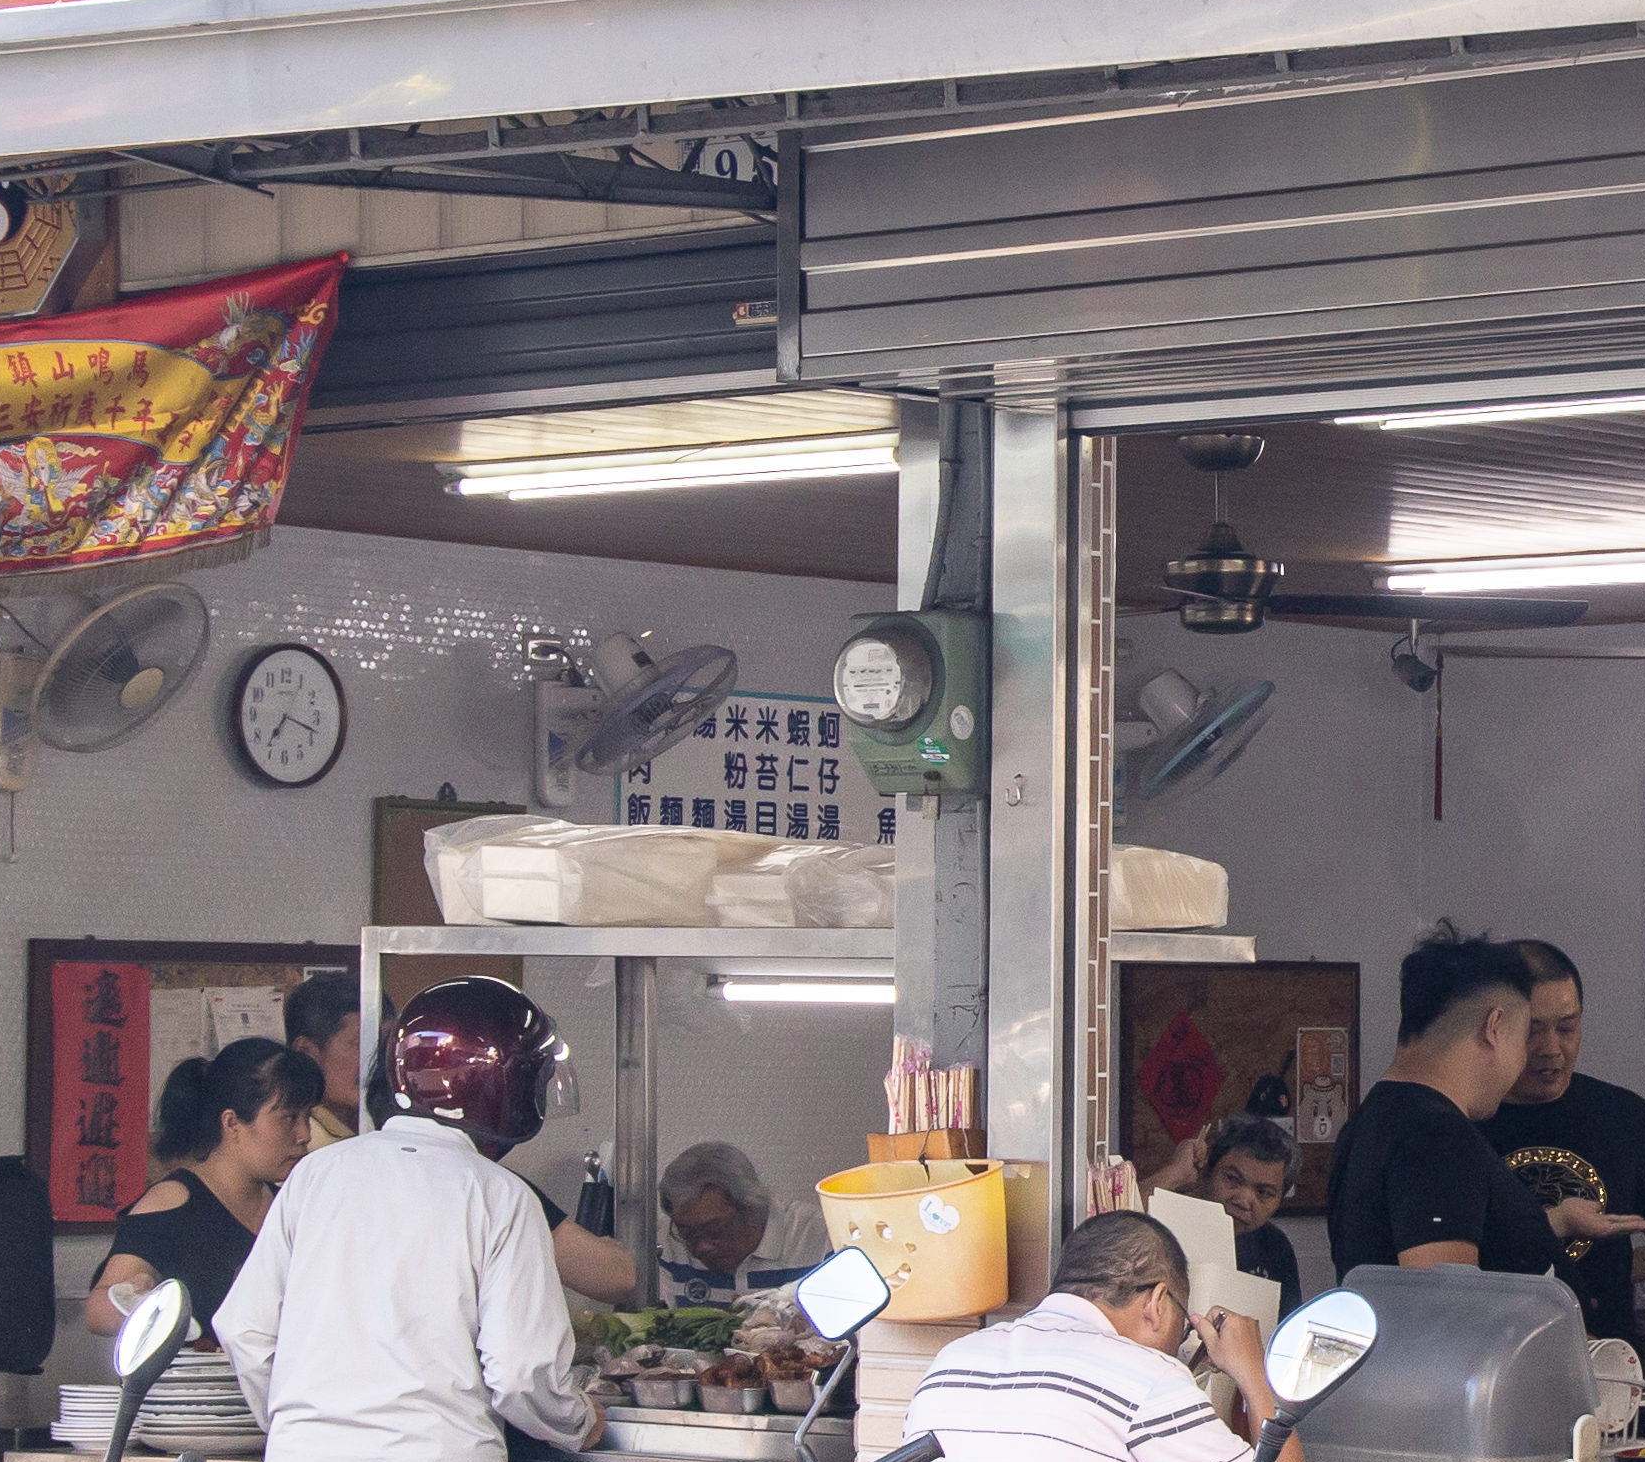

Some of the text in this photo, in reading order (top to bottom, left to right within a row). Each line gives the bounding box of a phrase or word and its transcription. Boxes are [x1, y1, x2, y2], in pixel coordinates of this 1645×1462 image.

[724, 703, 749, 834] 米粉湯
[755, 706, 780, 837] 米苔目
[785, 708, 811, 841] 蝦仁湯
[817, 710, 841, 841] 蚵仔湯
